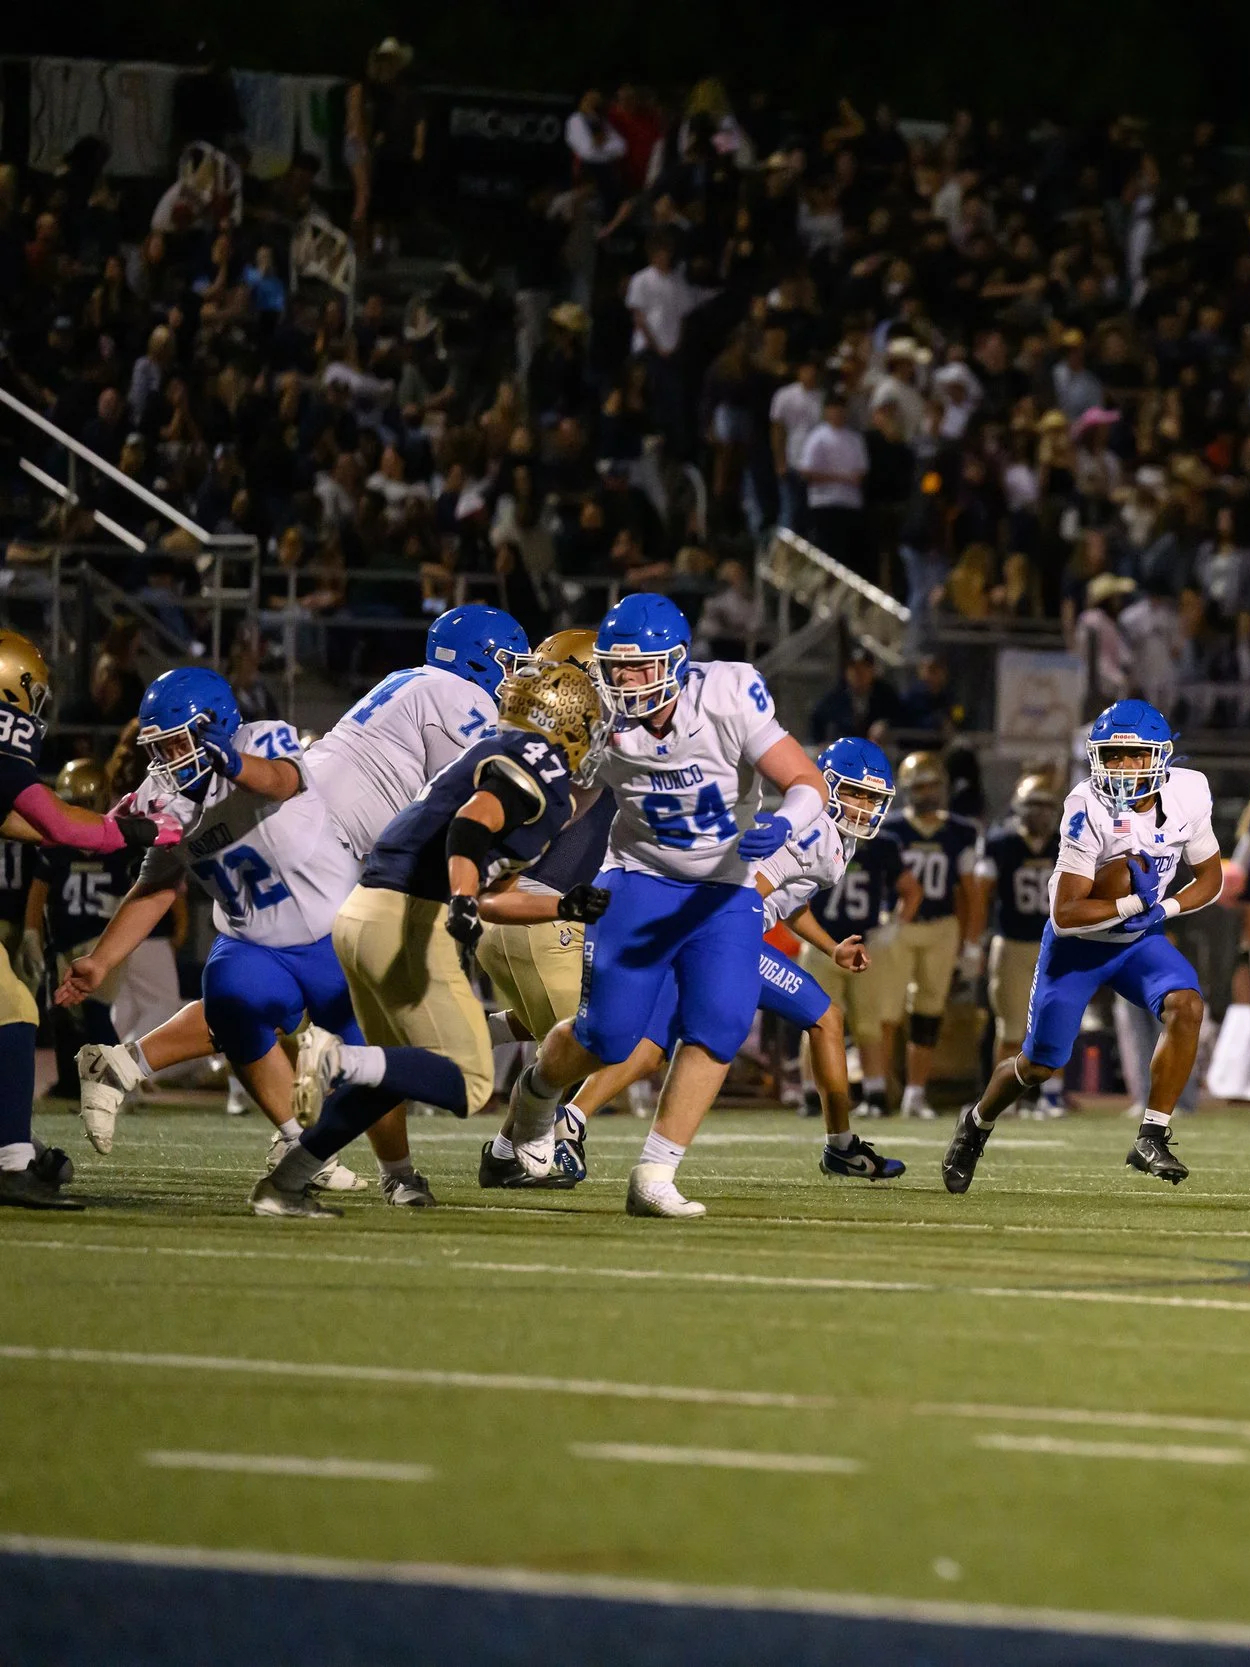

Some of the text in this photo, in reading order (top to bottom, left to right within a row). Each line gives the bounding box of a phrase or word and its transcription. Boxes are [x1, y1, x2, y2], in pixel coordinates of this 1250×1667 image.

[254, 727, 300, 759] 72
[656, 745, 668, 755] N
[522, 742, 567, 784] 47
[648, 763, 704, 792] NORCO
[641, 781, 739, 849] 64
[1068, 810, 1086, 840] 4
[797, 829, 822, 851] 1
[1154, 833, 1166, 844] N
[189, 844, 294, 918] 72
[759, 953, 803, 995] UGARS
